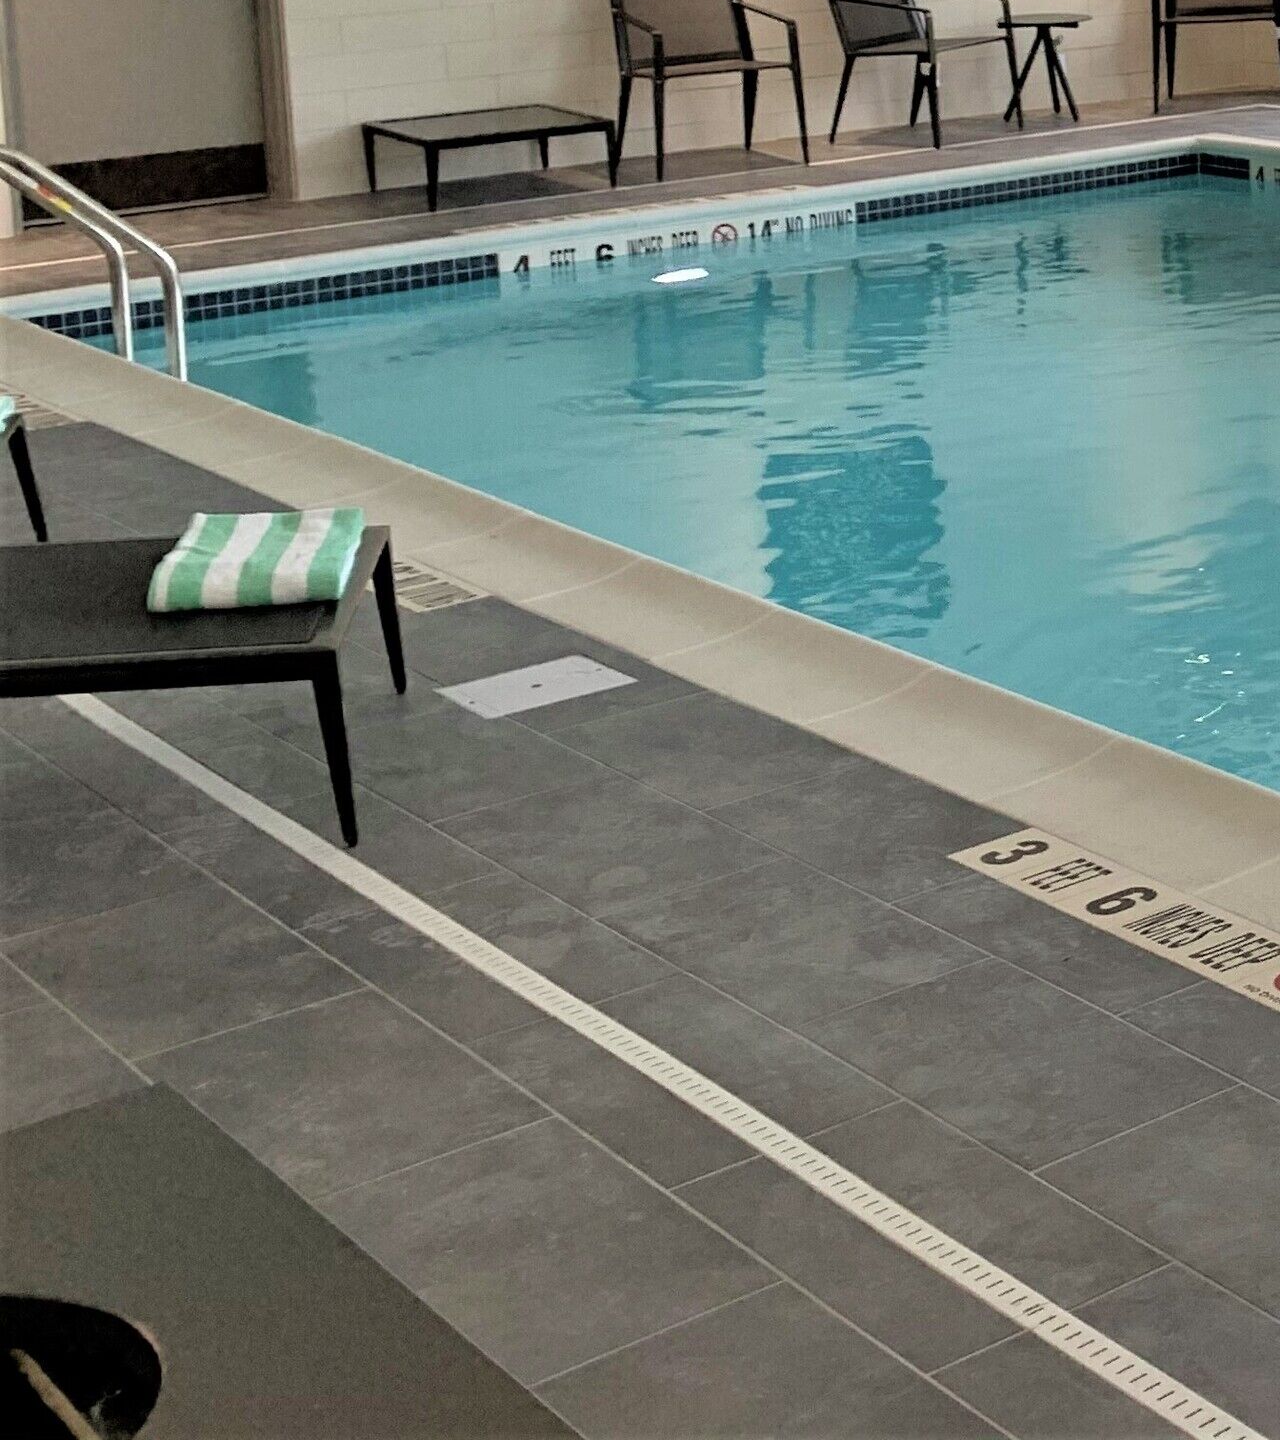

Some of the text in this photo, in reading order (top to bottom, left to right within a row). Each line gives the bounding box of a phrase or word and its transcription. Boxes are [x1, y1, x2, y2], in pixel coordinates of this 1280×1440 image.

[980, 840, 1049, 865] 3
[1021, 858, 1113, 894] FEET
[1086, 886, 1158, 915] 6
[1122, 903, 1233, 949] INCHES
